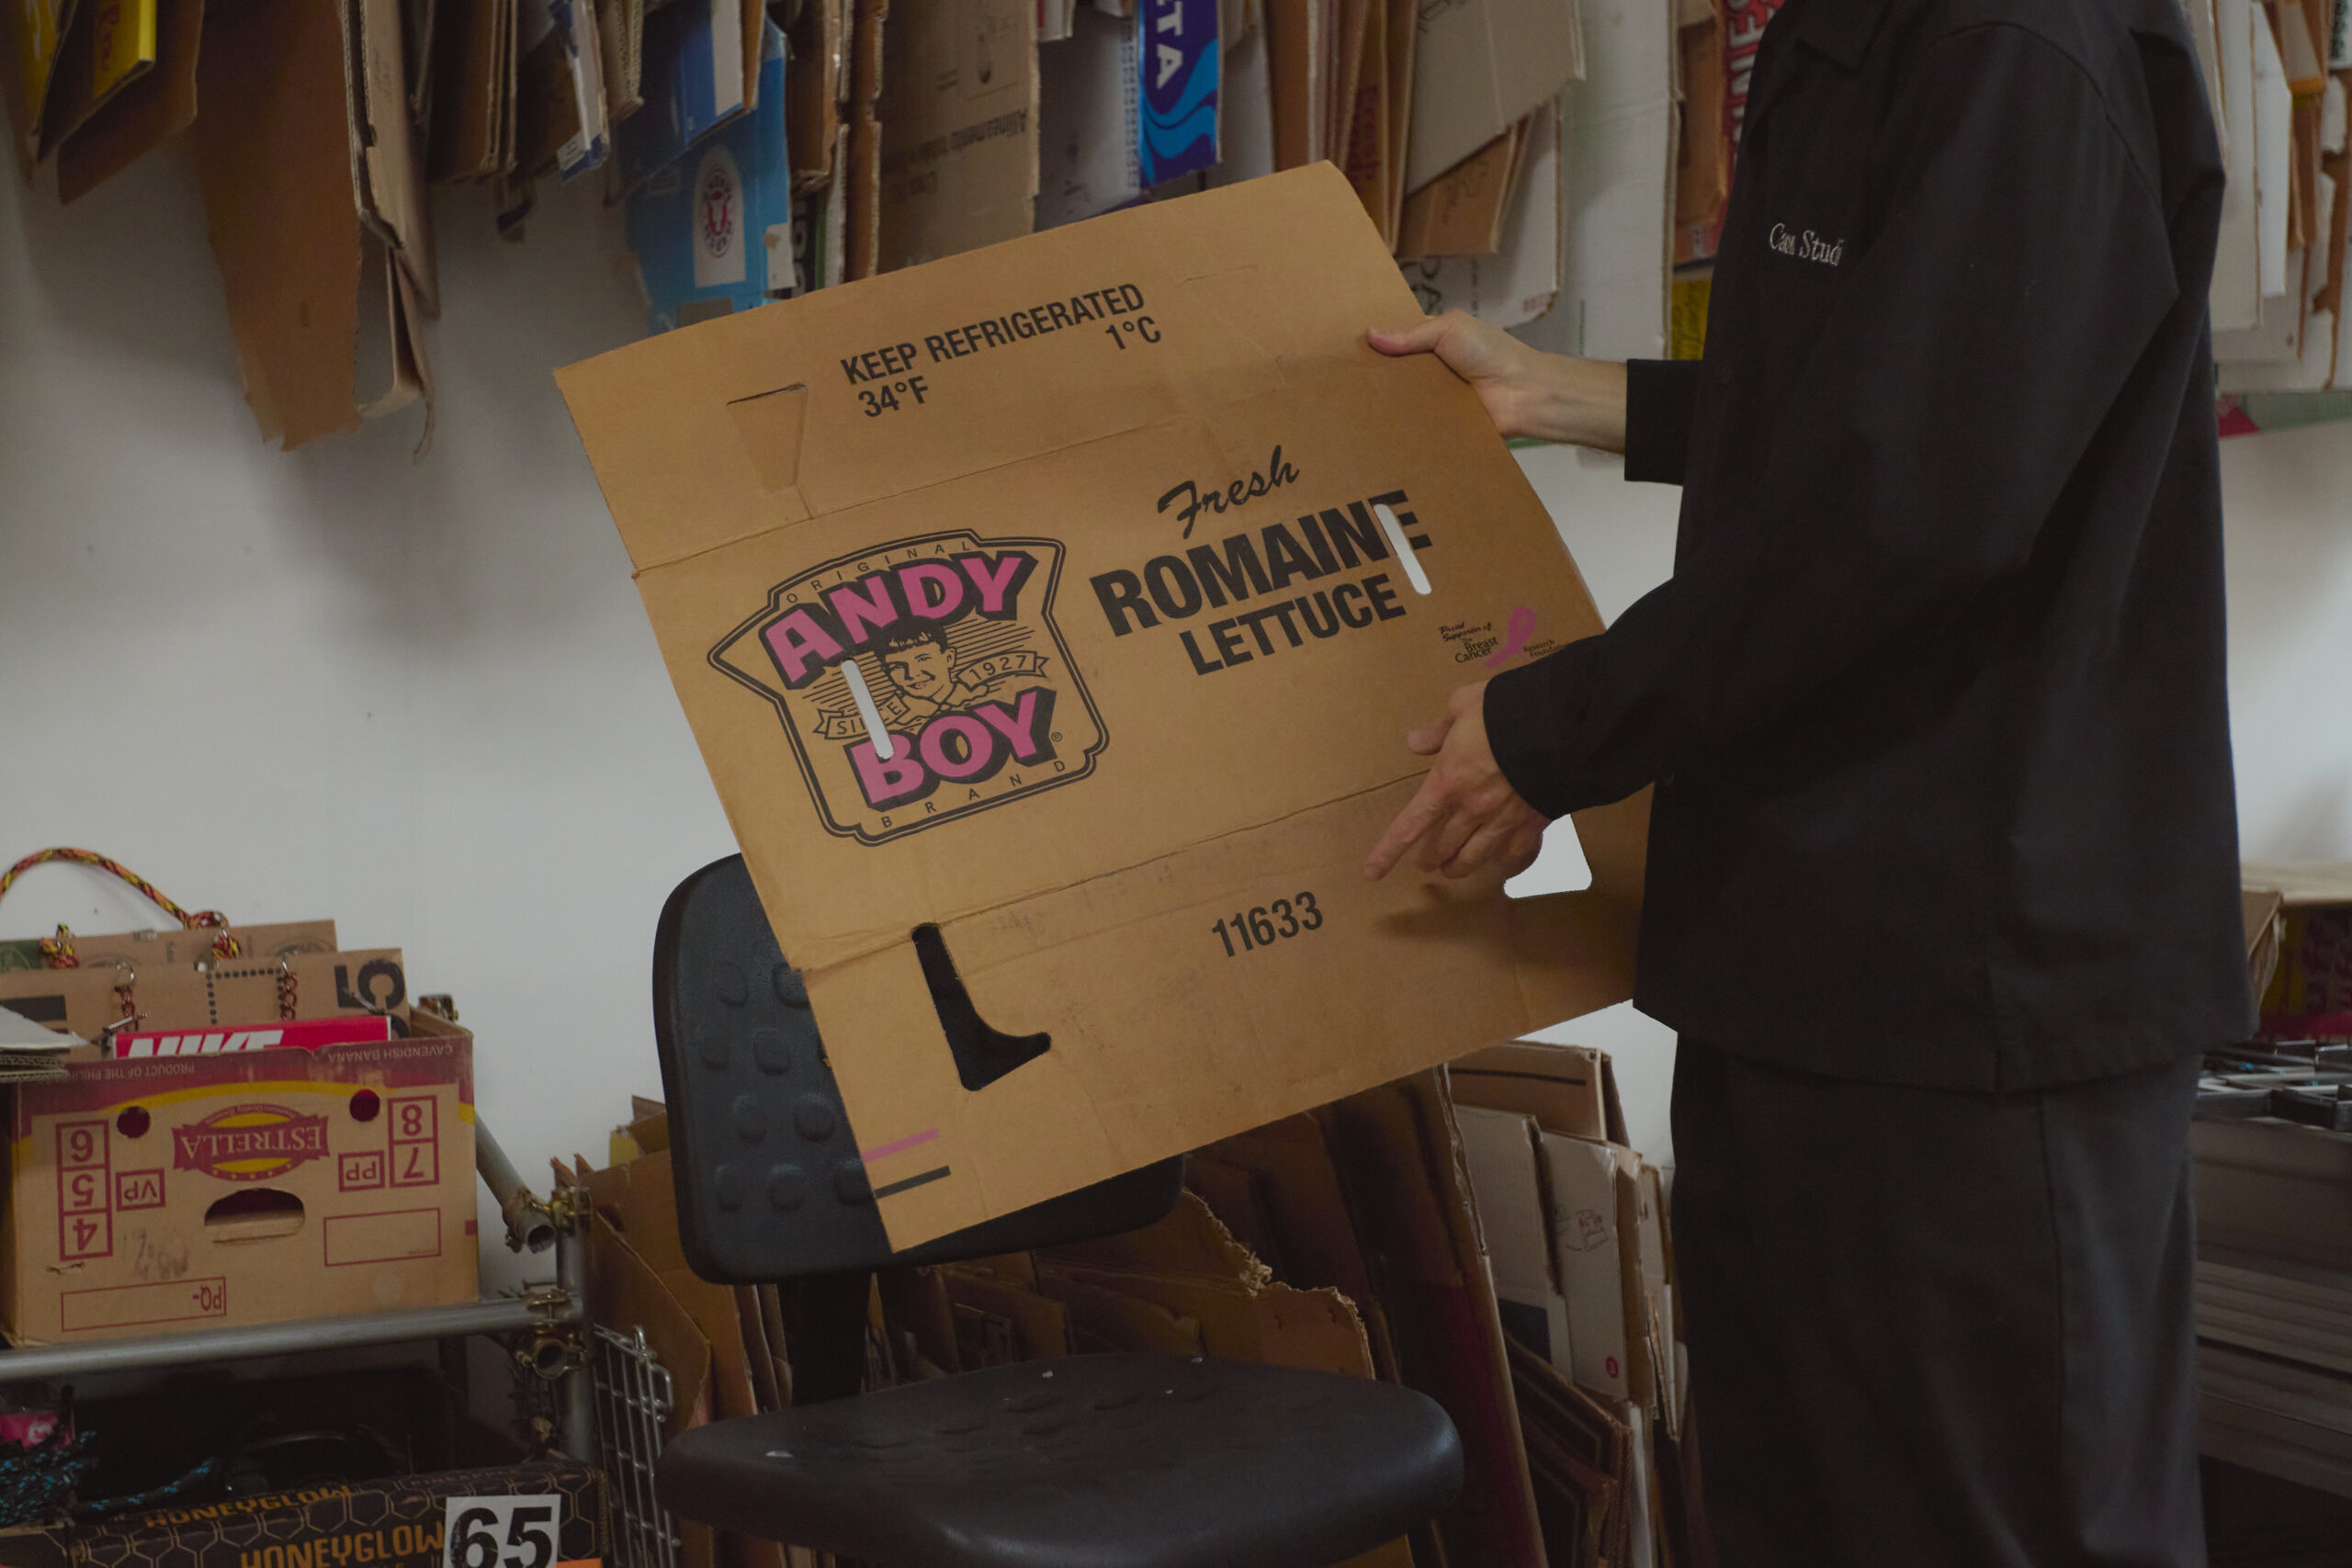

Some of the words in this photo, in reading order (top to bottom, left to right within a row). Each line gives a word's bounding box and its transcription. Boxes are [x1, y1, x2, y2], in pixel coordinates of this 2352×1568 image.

[1157, 0, 1183, 90] TA
[841, 342, 918, 385] KEEP
[924, 283, 1145, 363] REFRIGERATED
[858, 376, 929, 418] 34°F
[1105, 316, 1161, 350] 1°C
[1158, 445, 1300, 539] Fresh
[787, 541, 971, 604] ORIGINAL
[759, 550, 1039, 690] ANDY
[1179, 573, 1407, 676] LETTUCE
[1454, 647, 1493, 663] Cancer
[1464, 637, 1499, 653] Breast
[969, 654, 1028, 682] 1927
[837, 702, 902, 735] SIE
[842, 686, 1057, 812] BOY
[882, 761, 1065, 828] BRAND
[1211, 891, 1324, 957] 11633
[328, 1050, 382, 1064] BANANA
[383, 1043, 453, 1060] CAVENDISH
[106, 1066, 125, 1080] THE
[128, 1066, 142, 1078] OF
[145, 1062, 195, 1077] PRODUCT
[401, 1104, 423, 1136] 8
[71, 1129, 94, 1162] 6
[180, 1125, 322, 1160] ESTRELLA
[345, 1160, 377, 1181] PP
[402, 1147, 424, 1179] 7
[72, 1174, 95, 1207] 5
[124, 1179, 157, 1201] VP
[73, 1218, 97, 1251] 4
[144, 1483, 352, 1529] HONEYGLOW
[240, 1520, 444, 1568] HONEYGLOW
[450, 1506, 552, 1568] 65
